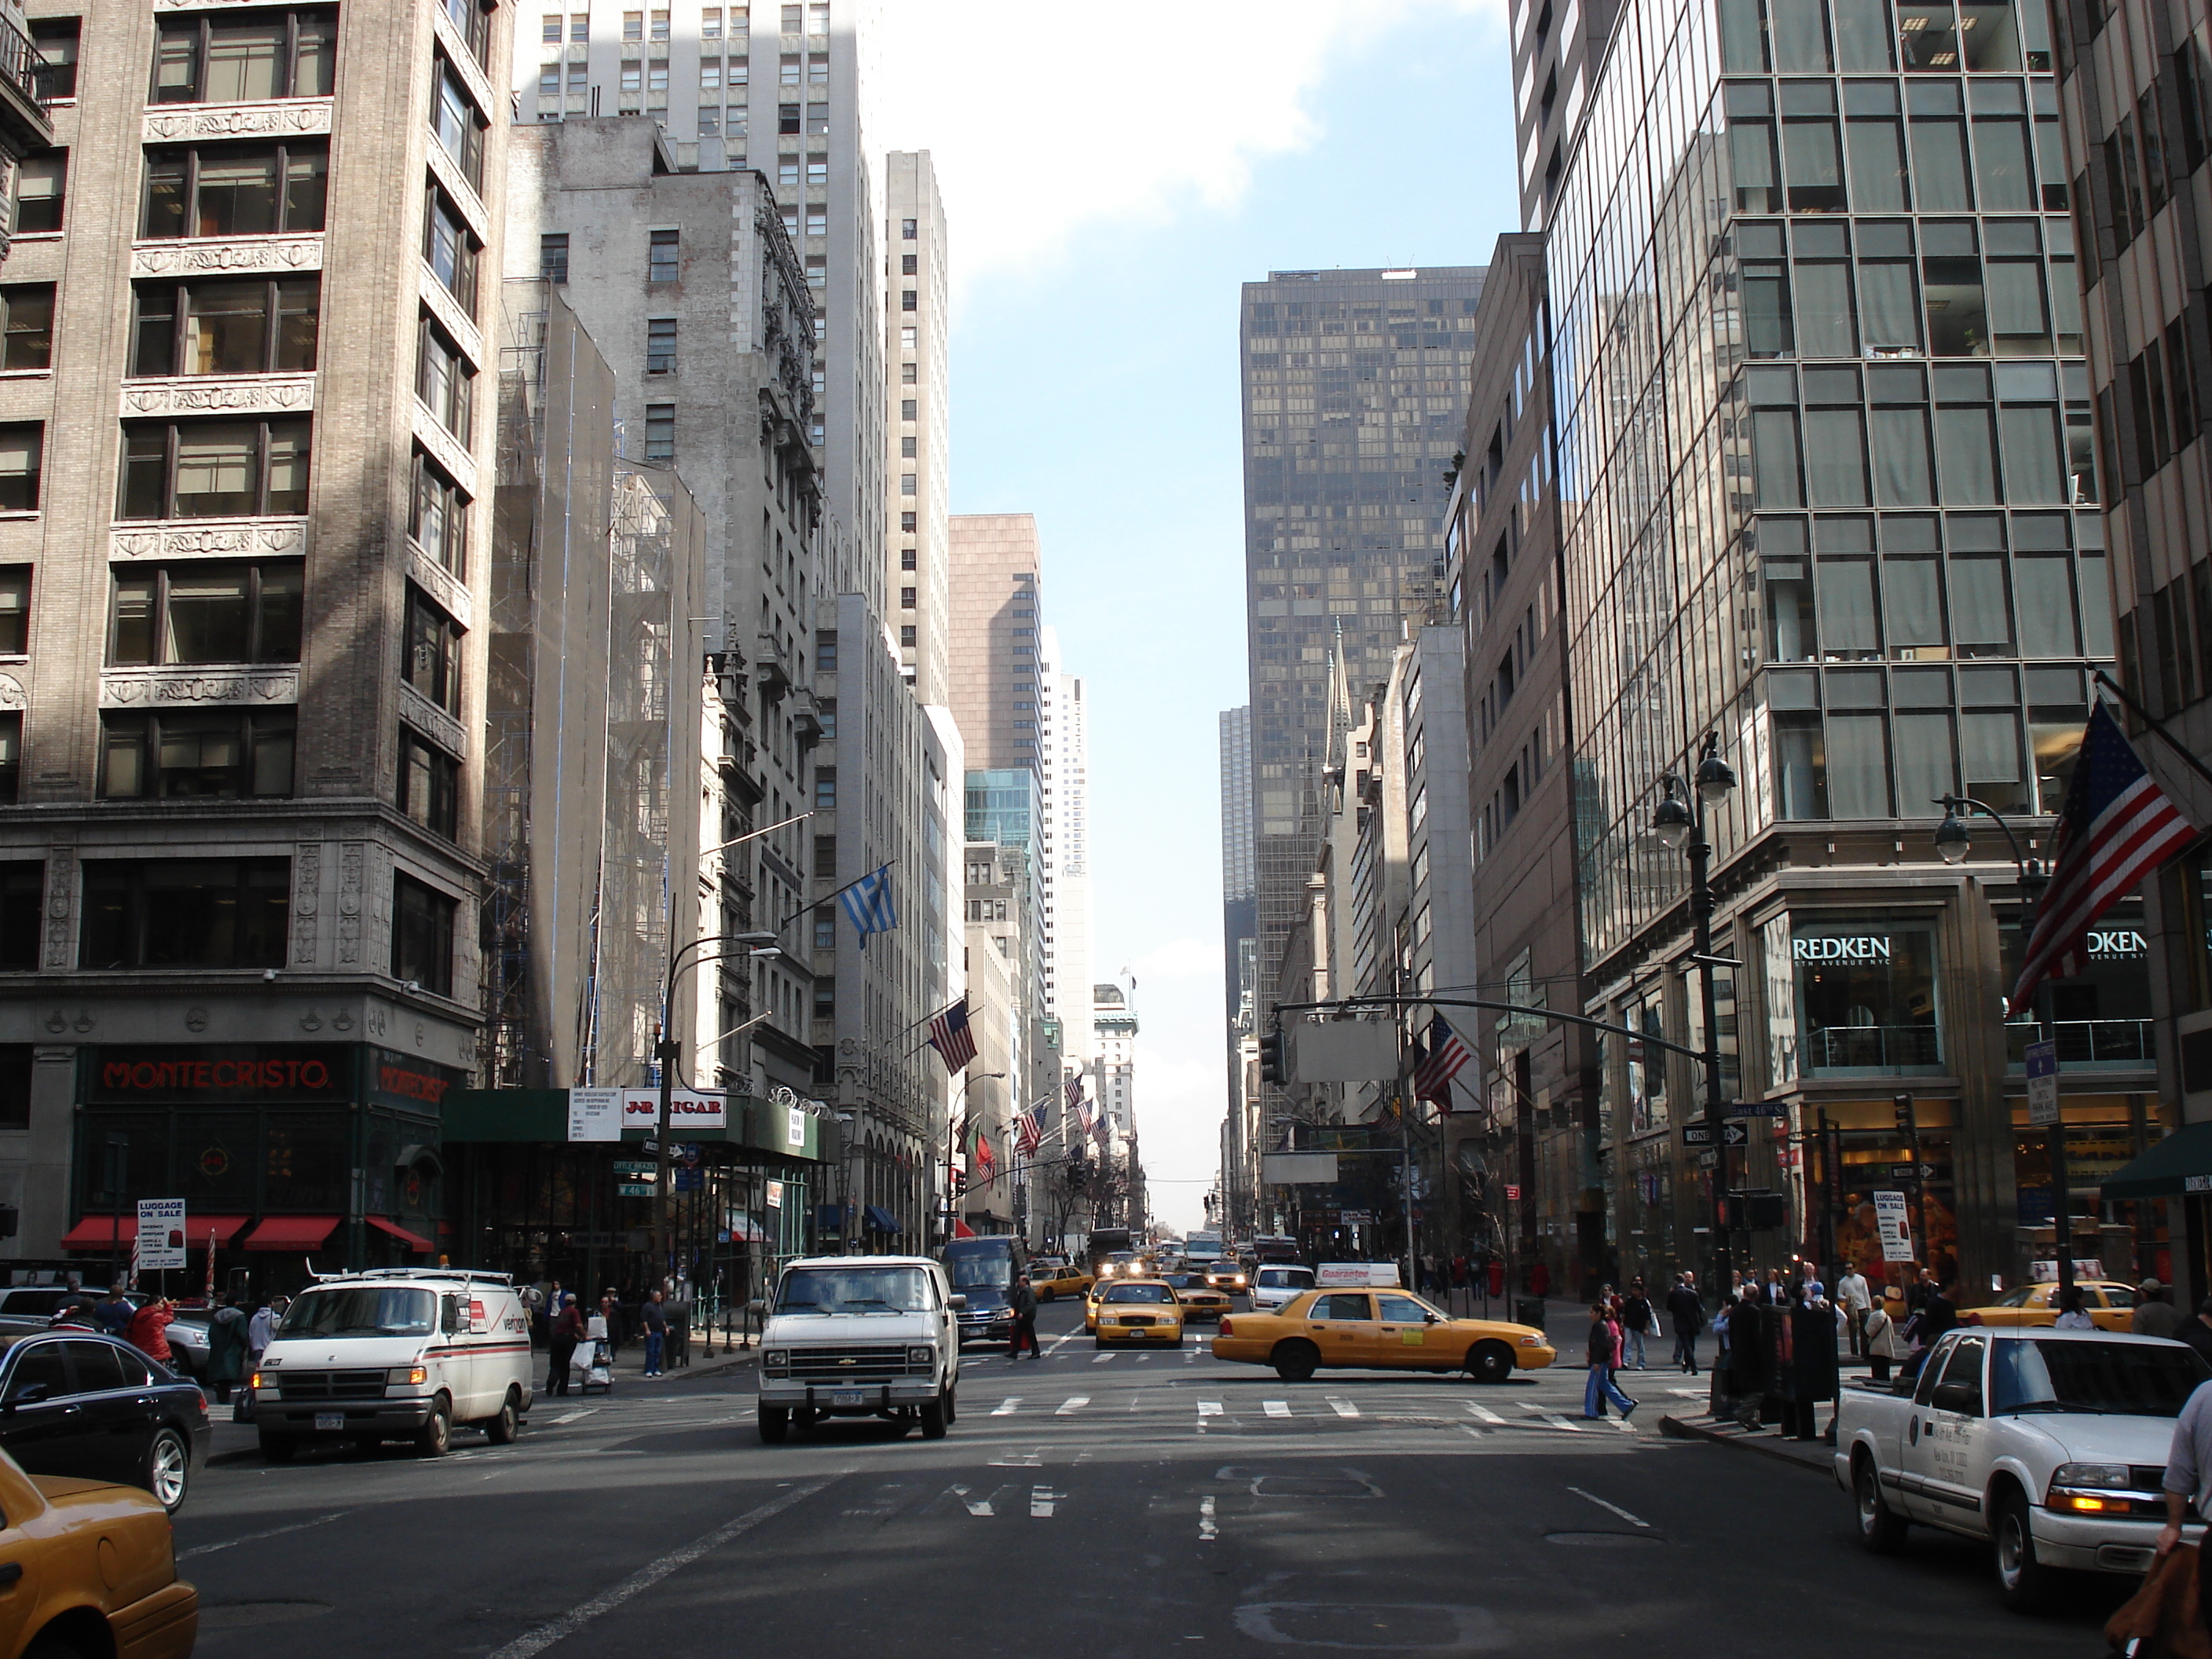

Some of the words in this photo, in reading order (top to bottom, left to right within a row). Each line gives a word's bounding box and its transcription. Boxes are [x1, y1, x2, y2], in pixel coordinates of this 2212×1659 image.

[1793, 936, 1890, 960] REDKEN
[2087, 931, 2148, 953] DKEN
[103, 1060, 328, 1090] MONTECRISTO
[1774, 1105, 1785, 1115] St
[1691, 1131, 1710, 1141] ONE
[1724, 1131, 1738, 1140] AY
[1322, 1269, 1369, 1279] Guarantee
[503, 1315, 526, 1333] verizon
